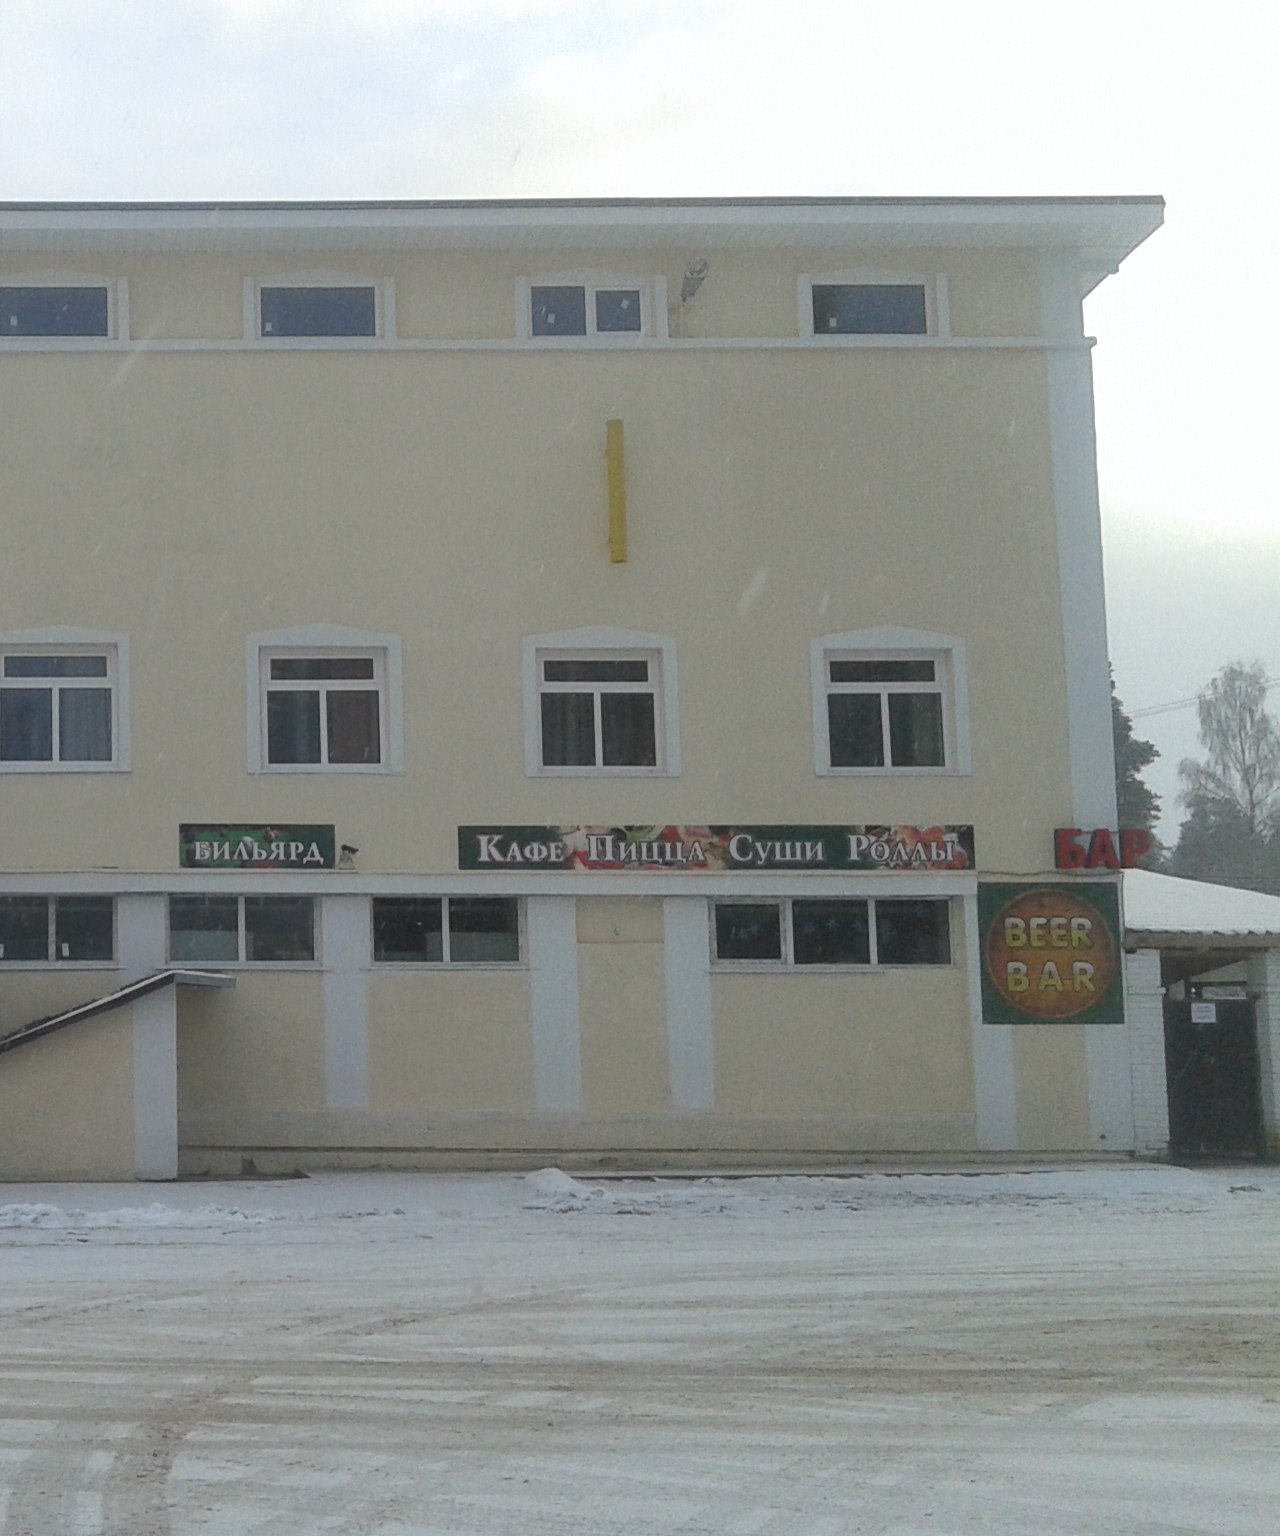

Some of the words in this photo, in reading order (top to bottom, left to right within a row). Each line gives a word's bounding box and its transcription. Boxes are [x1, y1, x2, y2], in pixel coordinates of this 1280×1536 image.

[194, 841, 325, 865] БИЛЬЯРД
[1054, 828, 1153, 869] БАР
[1004, 916, 1094, 948] BEER
[1006, 961, 1097, 992] BAR
